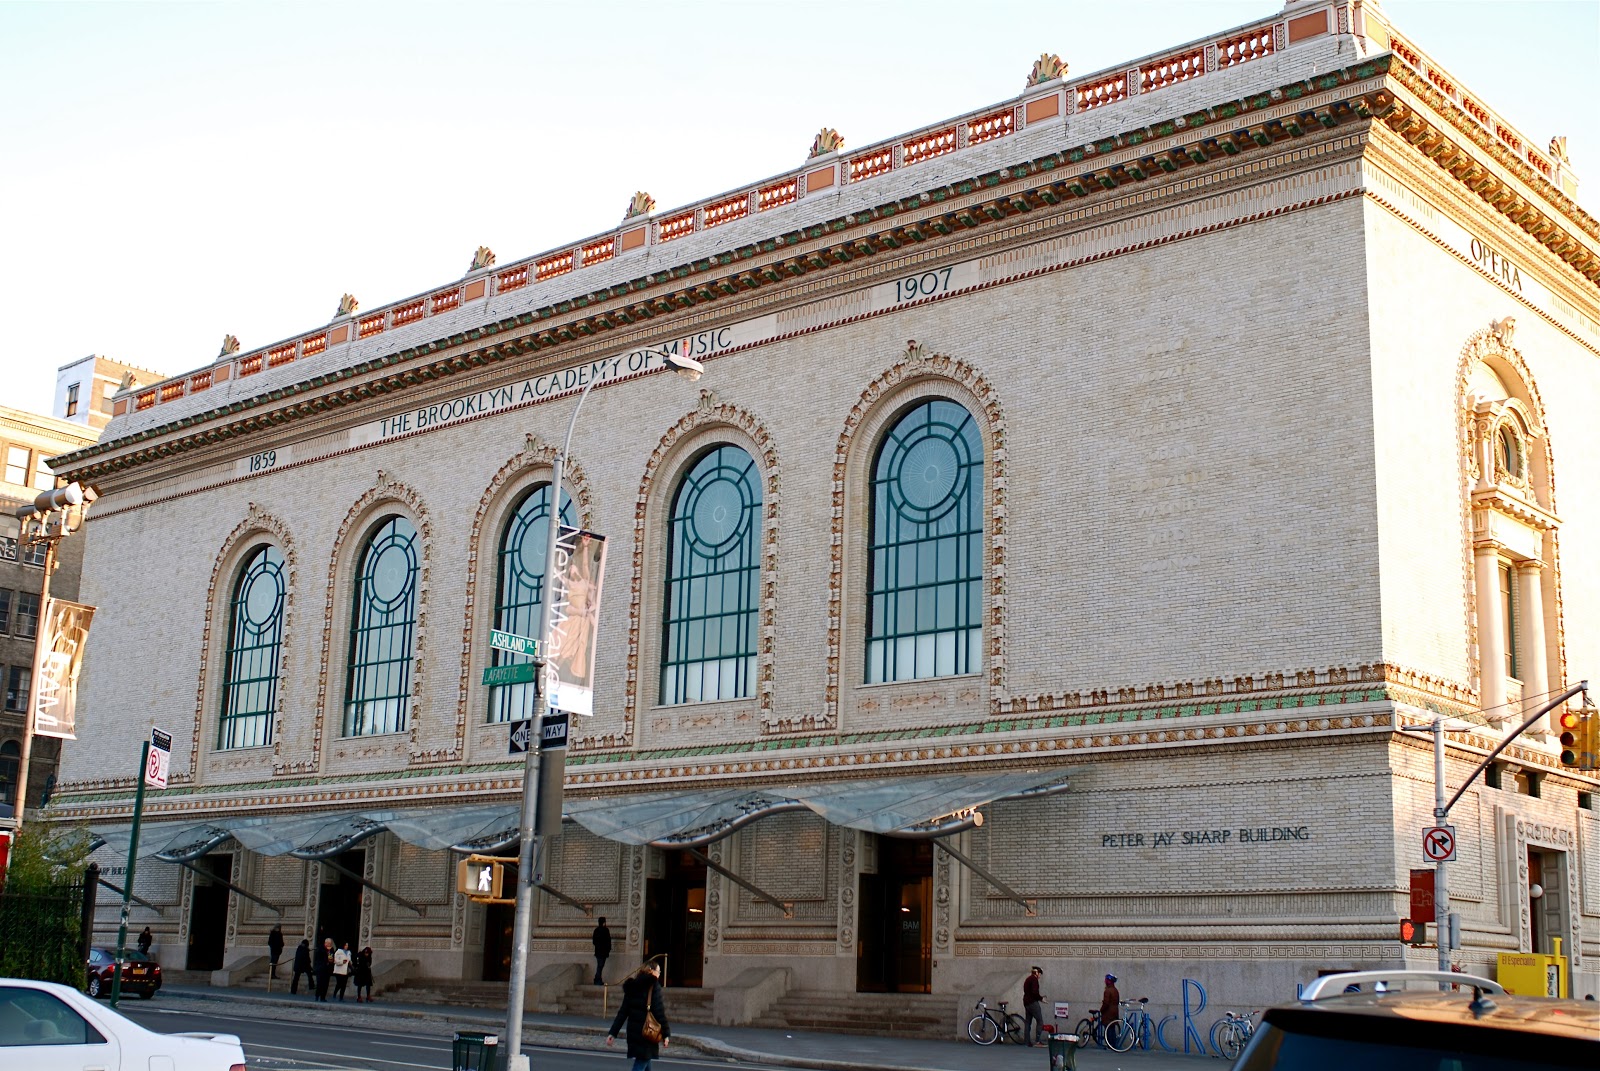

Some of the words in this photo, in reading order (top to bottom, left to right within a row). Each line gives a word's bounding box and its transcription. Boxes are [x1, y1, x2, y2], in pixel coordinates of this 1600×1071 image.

[1470, 238, 1522, 291] OPERA
[896, 267, 954, 303] 1907
[380, 412, 412, 437] THE
[417, 386, 514, 428] BROOKLYN
[520, 357, 621, 401] ACADEMY
[628, 350, 656, 371] OF
[249, 450, 277, 473] 1859
[492, 632, 526, 653] ASHLAND
[527, 640, 534, 649] PL
[484, 666, 519, 682] LAFAYETTE
[37, 651, 65, 727] BAM
[514, 729, 531, 743] ONE
[545, 724, 563, 738] WAY
[1102, 833, 1145, 848] PETER
[1152, 831, 1176, 849] JAY
[1182, 829, 1232, 845] SHARP
[1239, 826, 1310, 843] BUILDING
[902, 920, 920, 930] BAM
[1502, 956, 1507, 965] El
